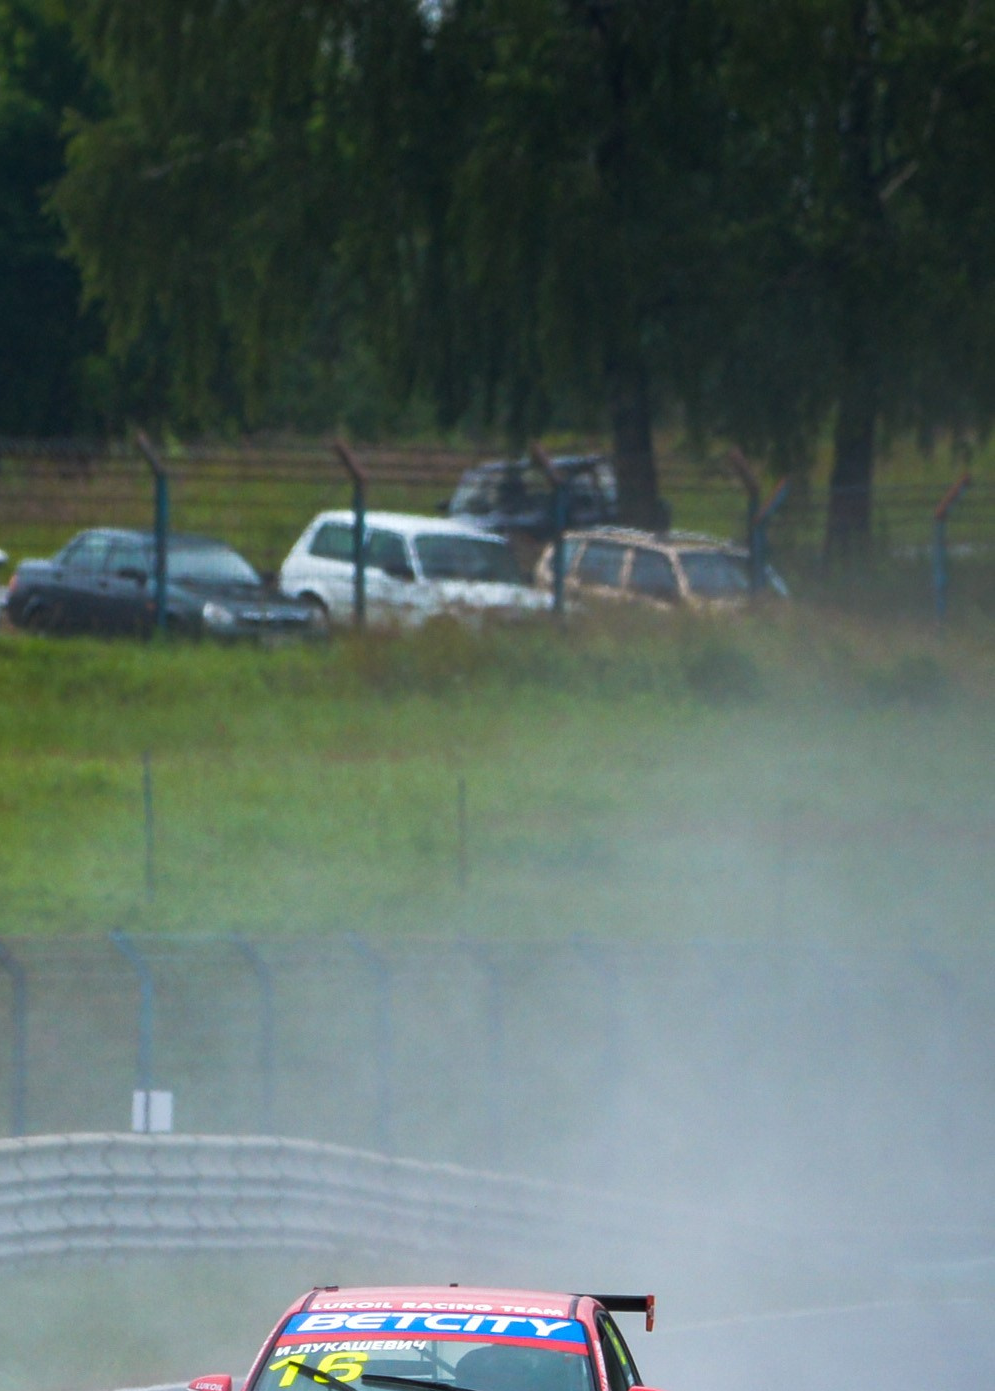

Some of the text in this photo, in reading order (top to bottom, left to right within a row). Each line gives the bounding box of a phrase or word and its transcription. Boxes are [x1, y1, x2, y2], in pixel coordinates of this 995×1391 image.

[312, 1302, 564, 1316] LUKOIL RACING TEAM
[269, 1352, 368, 1387] 16
